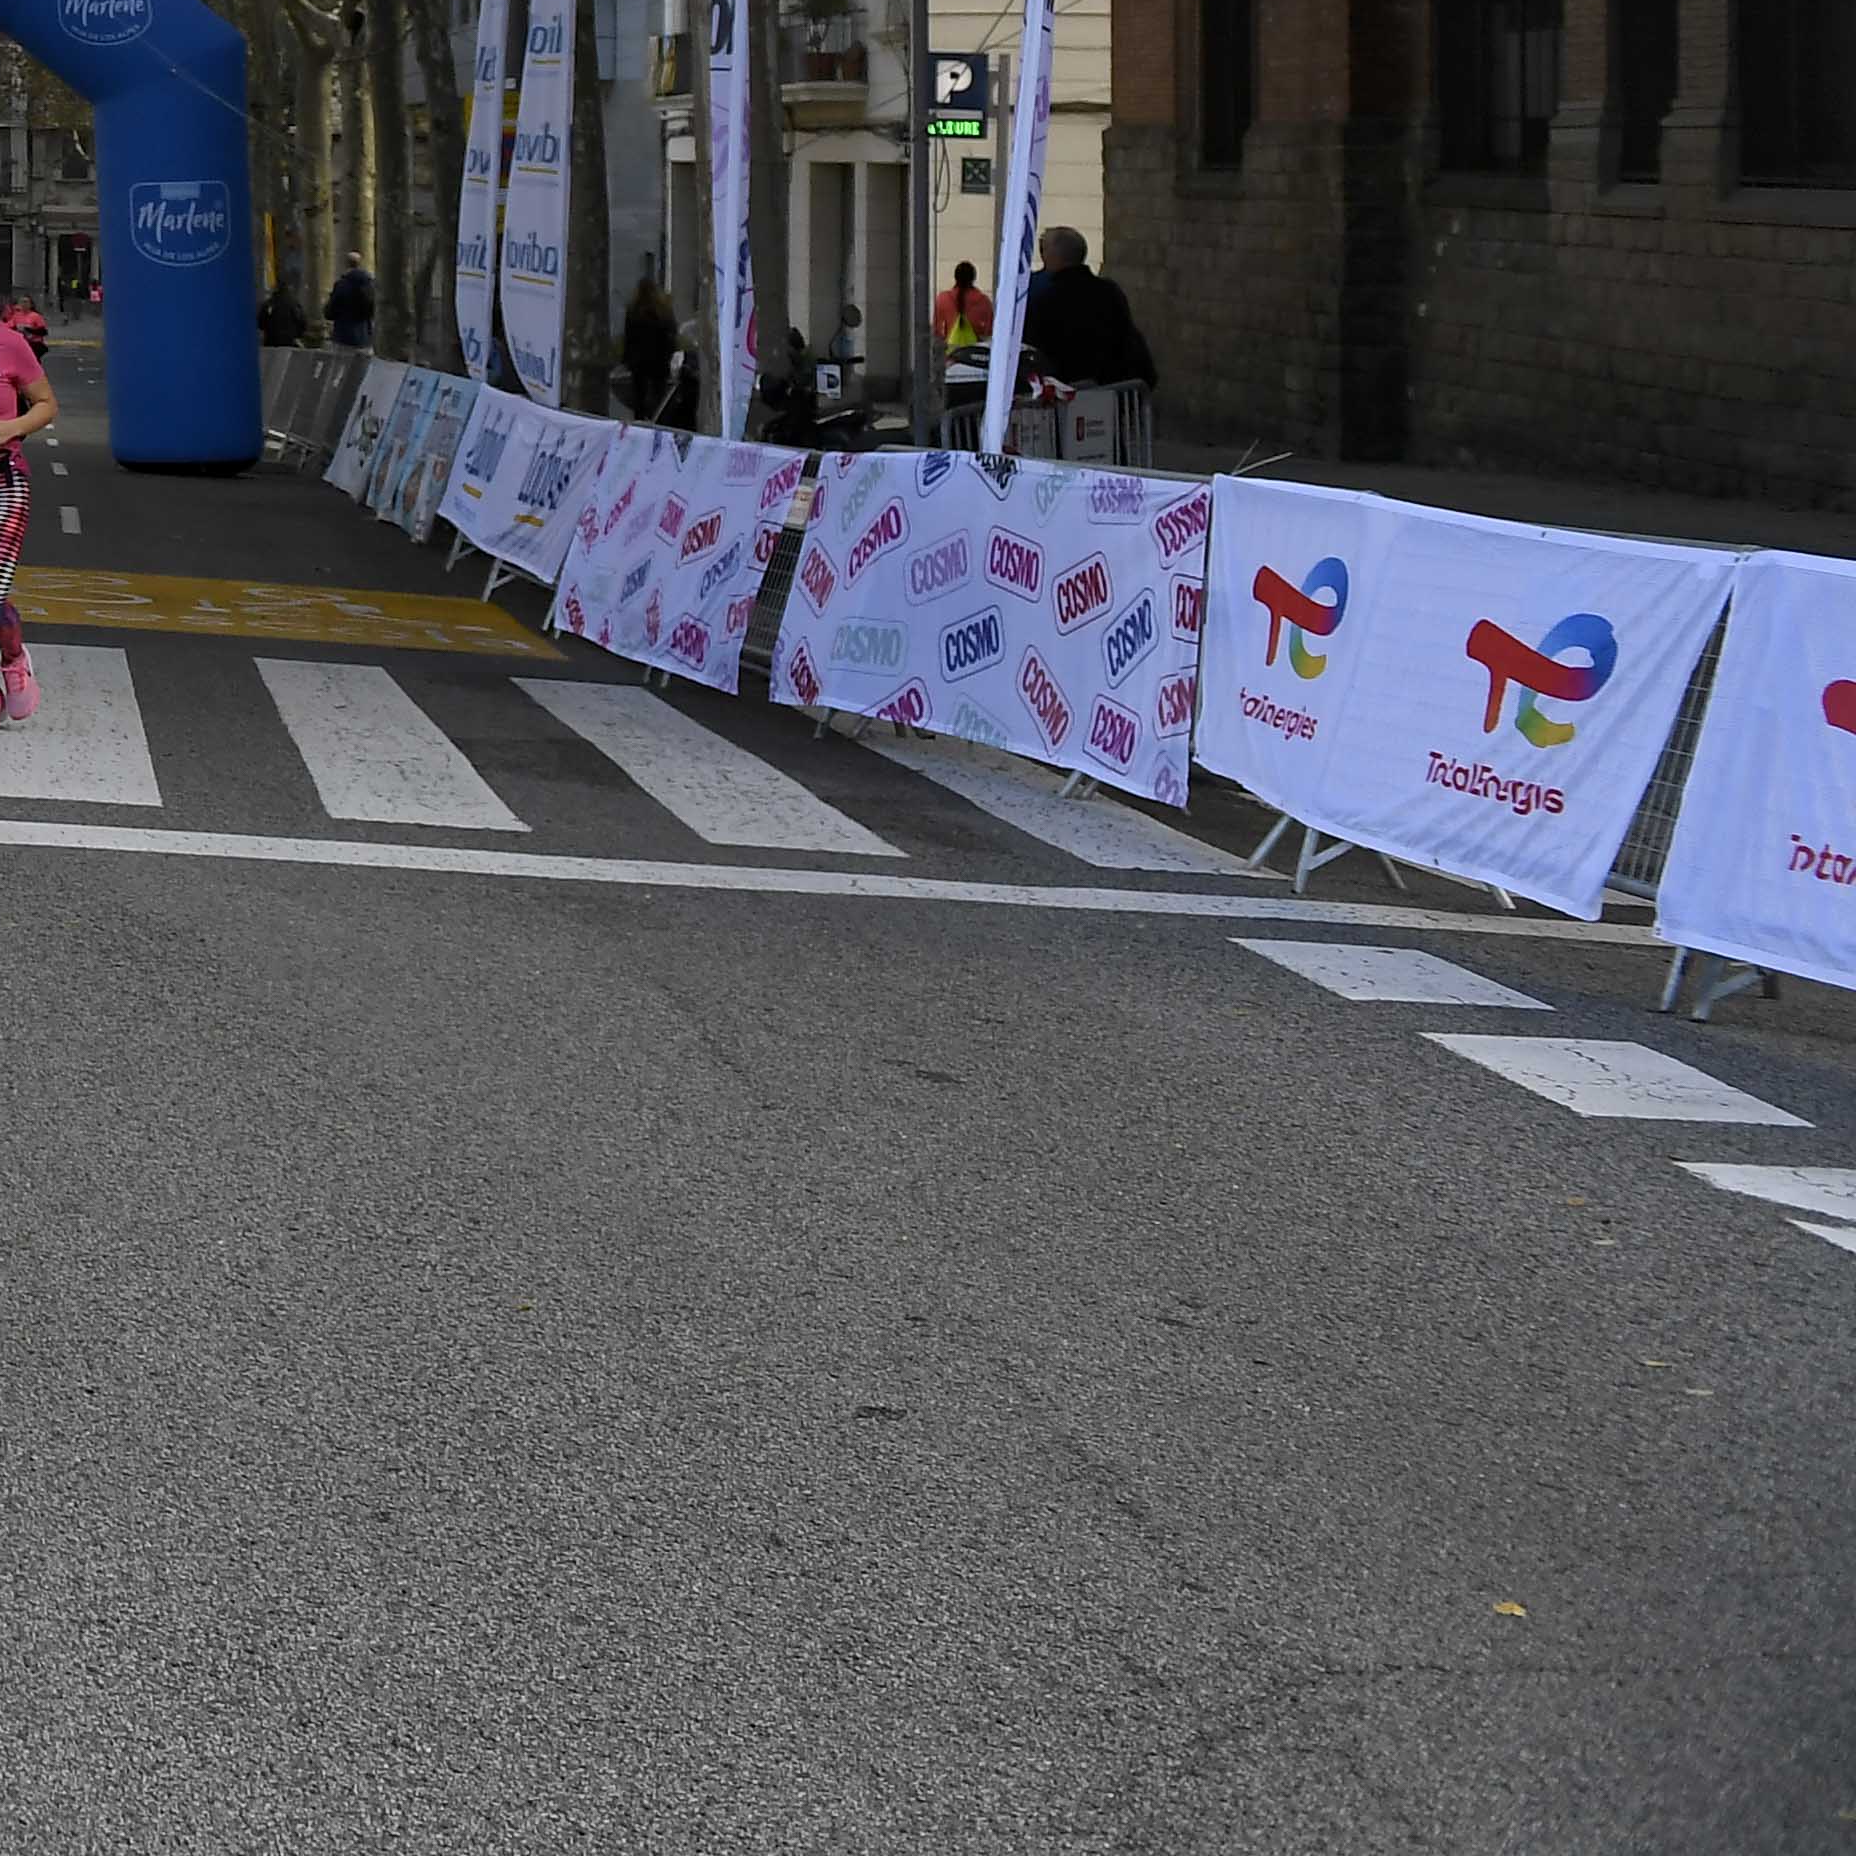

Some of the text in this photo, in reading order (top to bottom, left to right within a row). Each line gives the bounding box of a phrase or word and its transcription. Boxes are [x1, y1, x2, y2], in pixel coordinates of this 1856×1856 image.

[936, 60, 972, 104] P
[138, 201, 224, 243] Marlene
[849, 505, 901, 579] COSMO
[911, 537, 968, 594] COSMO
[991, 534, 1038, 592] COSMO
[1057, 561, 1108, 624] COSMO
[945, 615, 1000, 671] COSMO
[1107, 598, 1153, 677] COSMO
[1023, 657, 1069, 746] COSMO
[1090, 703, 1136, 765] COSMO
